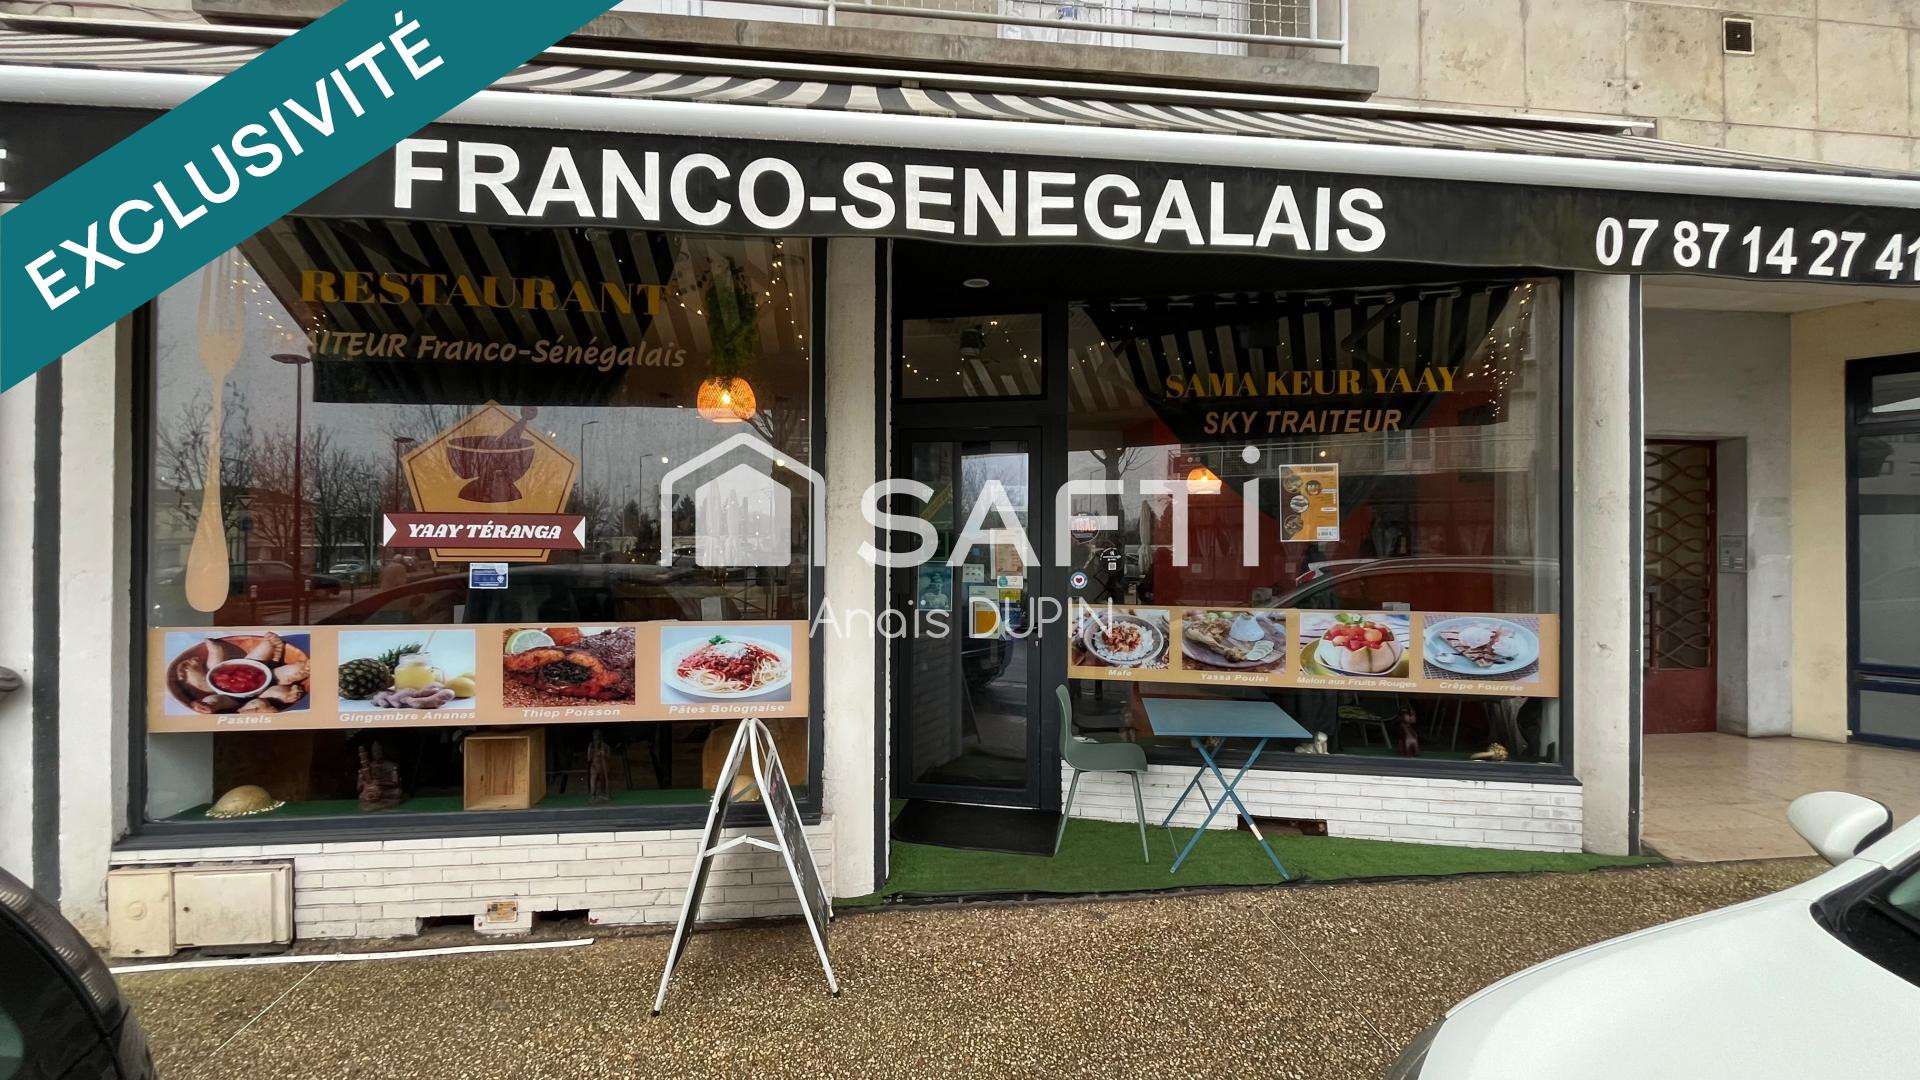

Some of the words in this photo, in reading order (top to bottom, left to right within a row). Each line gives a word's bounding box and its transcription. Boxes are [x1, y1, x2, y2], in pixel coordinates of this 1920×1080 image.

[395, 139, 1386, 253] FRANCO-SENEGALAIS
[1595, 216, 1659, 266] 07
[1673, 220, 1730, 269] 87
[1742, 225, 1798, 275] 14
[1808, 229, 1866, 278] 27
[1874, 233, 1920, 281] 41
[301, 269, 672, 316] RESTAURANT
[416, 333, 686, 372] Franco-Sénégalais
[1166, 372, 1258, 399] SAMA
[1267, 368, 1363, 397] KEUR
[1370, 366, 1459, 394] YAAY
[1203, 410, 1258, 435] SKY
[1266, 408, 1402, 434] TRAITEUR
[408, 523, 464, 538] YAAY
[466, 520, 562, 539] TÉRANGA
[1234, 674, 1269, 683] Poulet
[1347, 678, 1376, 687] Fruits
[1378, 679, 1417, 689] Rouges
[339, 711, 418, 723] Gingembre
[564, 707, 621, 718] Poisson
[668, 703, 705, 715] Pâtes
[709, 703, 785, 716] Bolognaise
[216, 714, 273, 726] Pastels
